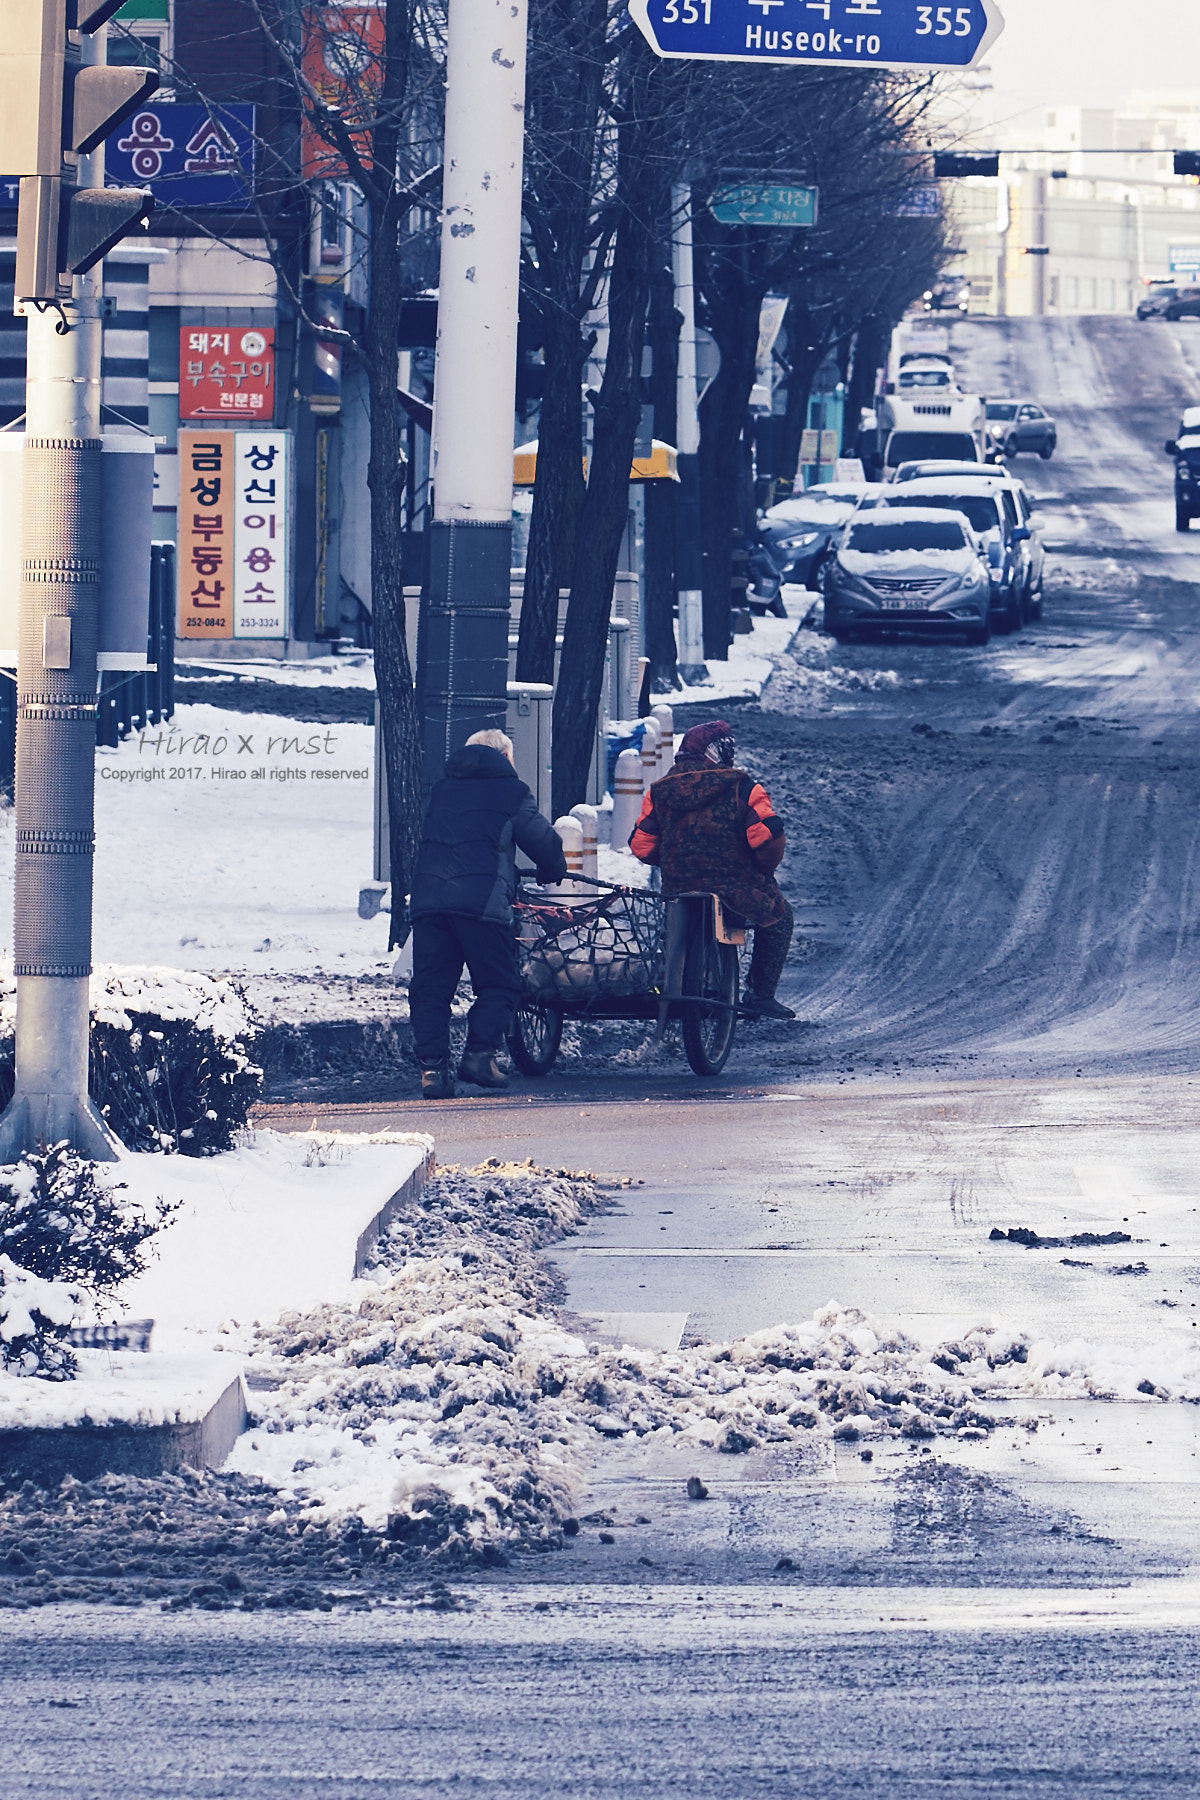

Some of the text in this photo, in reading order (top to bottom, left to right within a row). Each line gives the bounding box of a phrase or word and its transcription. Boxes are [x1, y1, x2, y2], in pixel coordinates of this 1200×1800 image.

[661, 0, 712, 24] 351
[914, 6, 972, 36] 355
[745, 25, 881, 54] Huseok-ro
[188, 332, 230, 356] 돼지
[185, 360, 270, 388] 부속구이
[220, 392, 263, 408] 전문점
[186, 617, 226, 627] 252-0842
[240, 618, 279, 627] 253-3324
